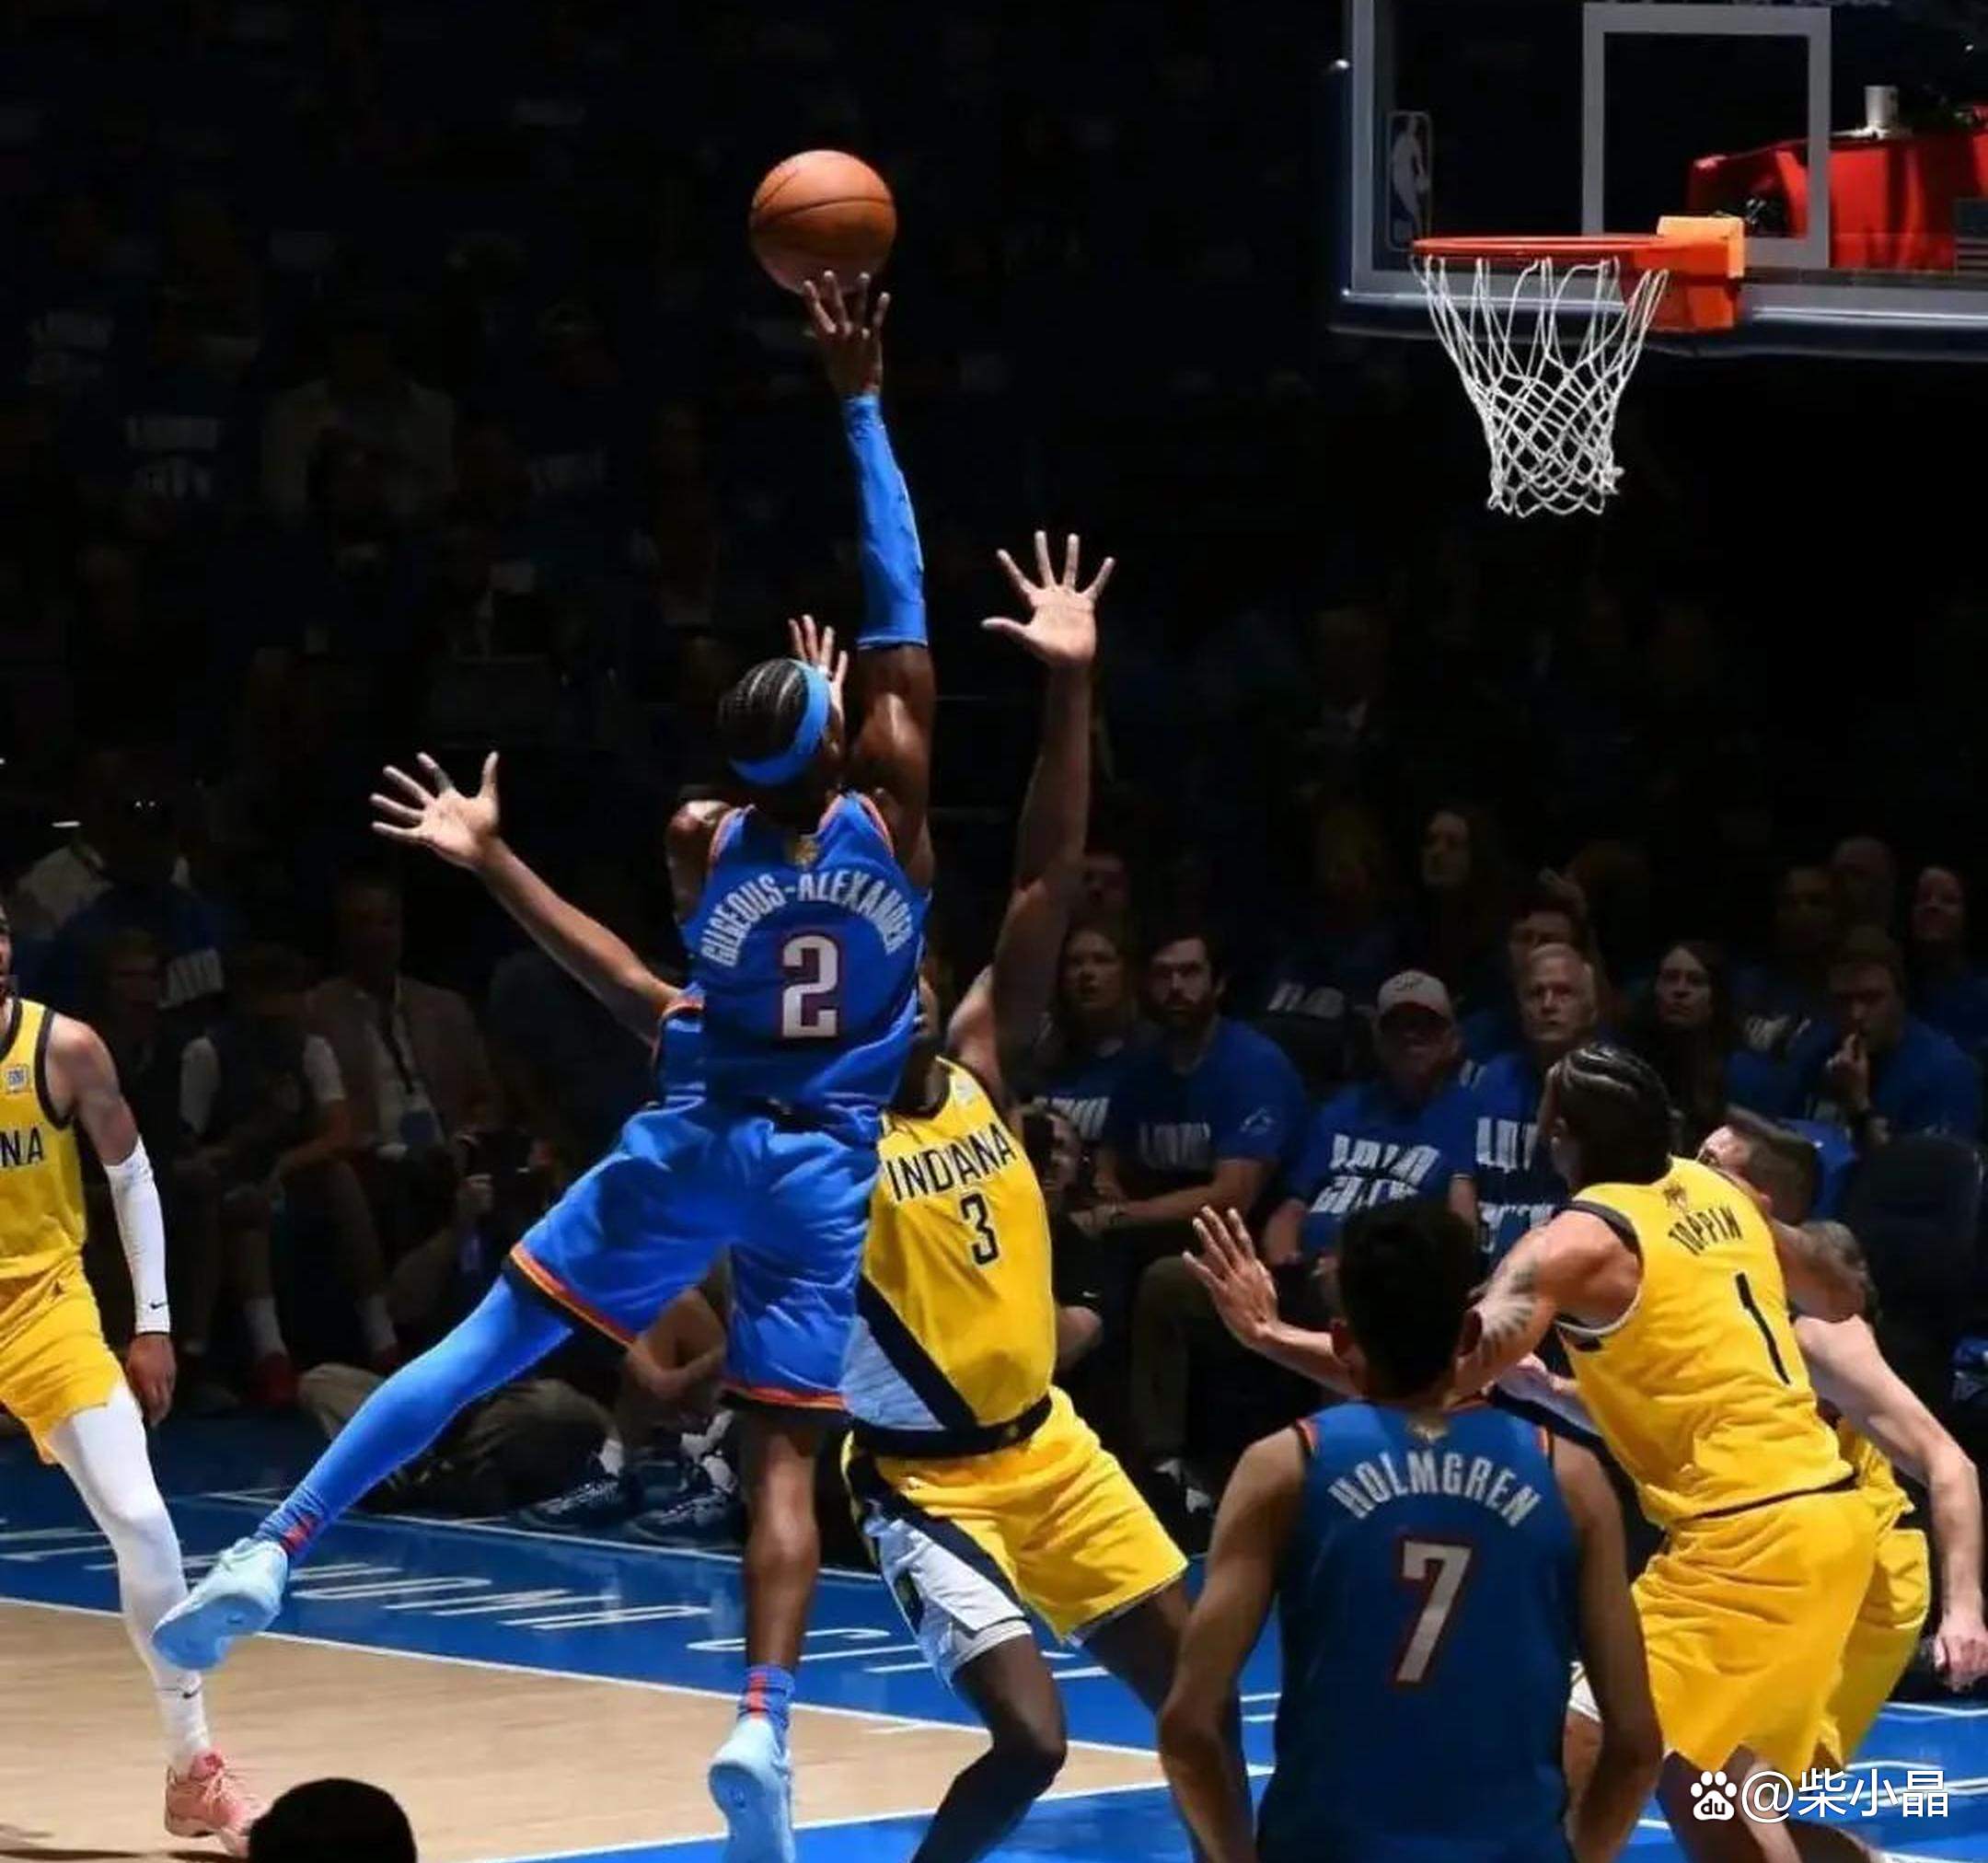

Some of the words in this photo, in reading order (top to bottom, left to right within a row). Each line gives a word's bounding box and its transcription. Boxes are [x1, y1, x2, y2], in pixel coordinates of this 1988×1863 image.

[781, 934, 839, 1038] 2
[960, 1193, 1000, 1265] 3
[1668, 1205, 1743, 1256] TOPPIN
[1735, 1272, 1791, 1385] 1
[1327, 1449, 1543, 1528] HOLMGREN
[1396, 1540, 1473, 1683] 7
